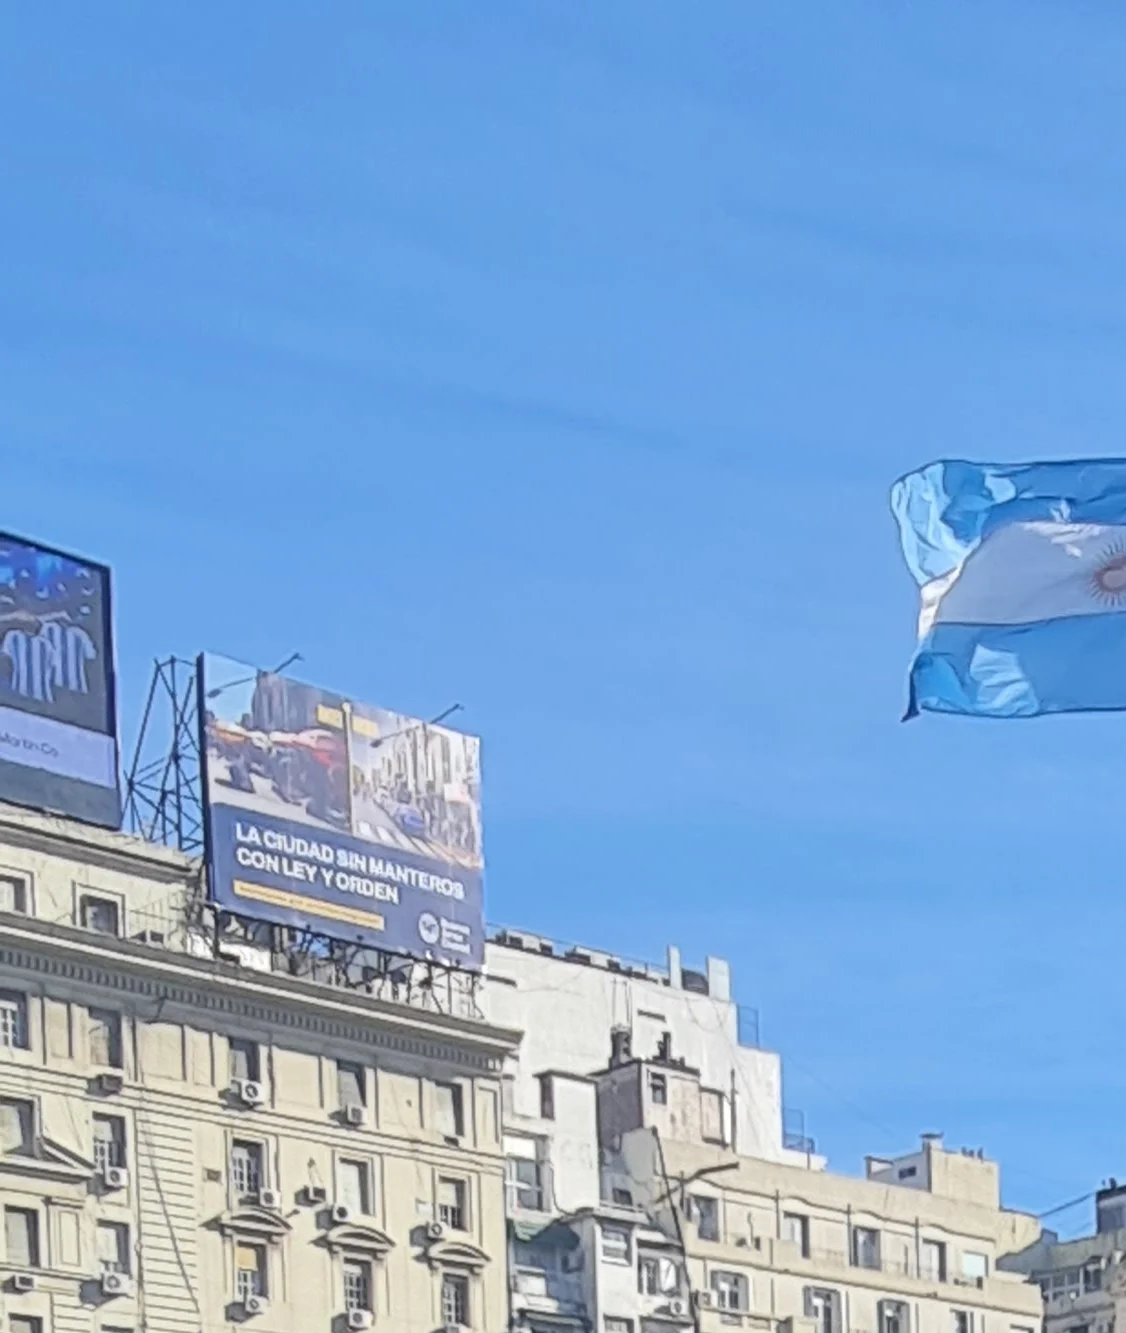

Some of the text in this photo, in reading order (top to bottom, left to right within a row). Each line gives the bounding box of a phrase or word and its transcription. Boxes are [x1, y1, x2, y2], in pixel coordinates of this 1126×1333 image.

[235, 822, 465, 900] LA CIUDAD SIN MANTEROS
[236, 847, 280, 874] CON
[282, 858, 318, 884] LEY
[320, 868, 333, 888] Y
[335, 873, 400, 905] ORDEN
